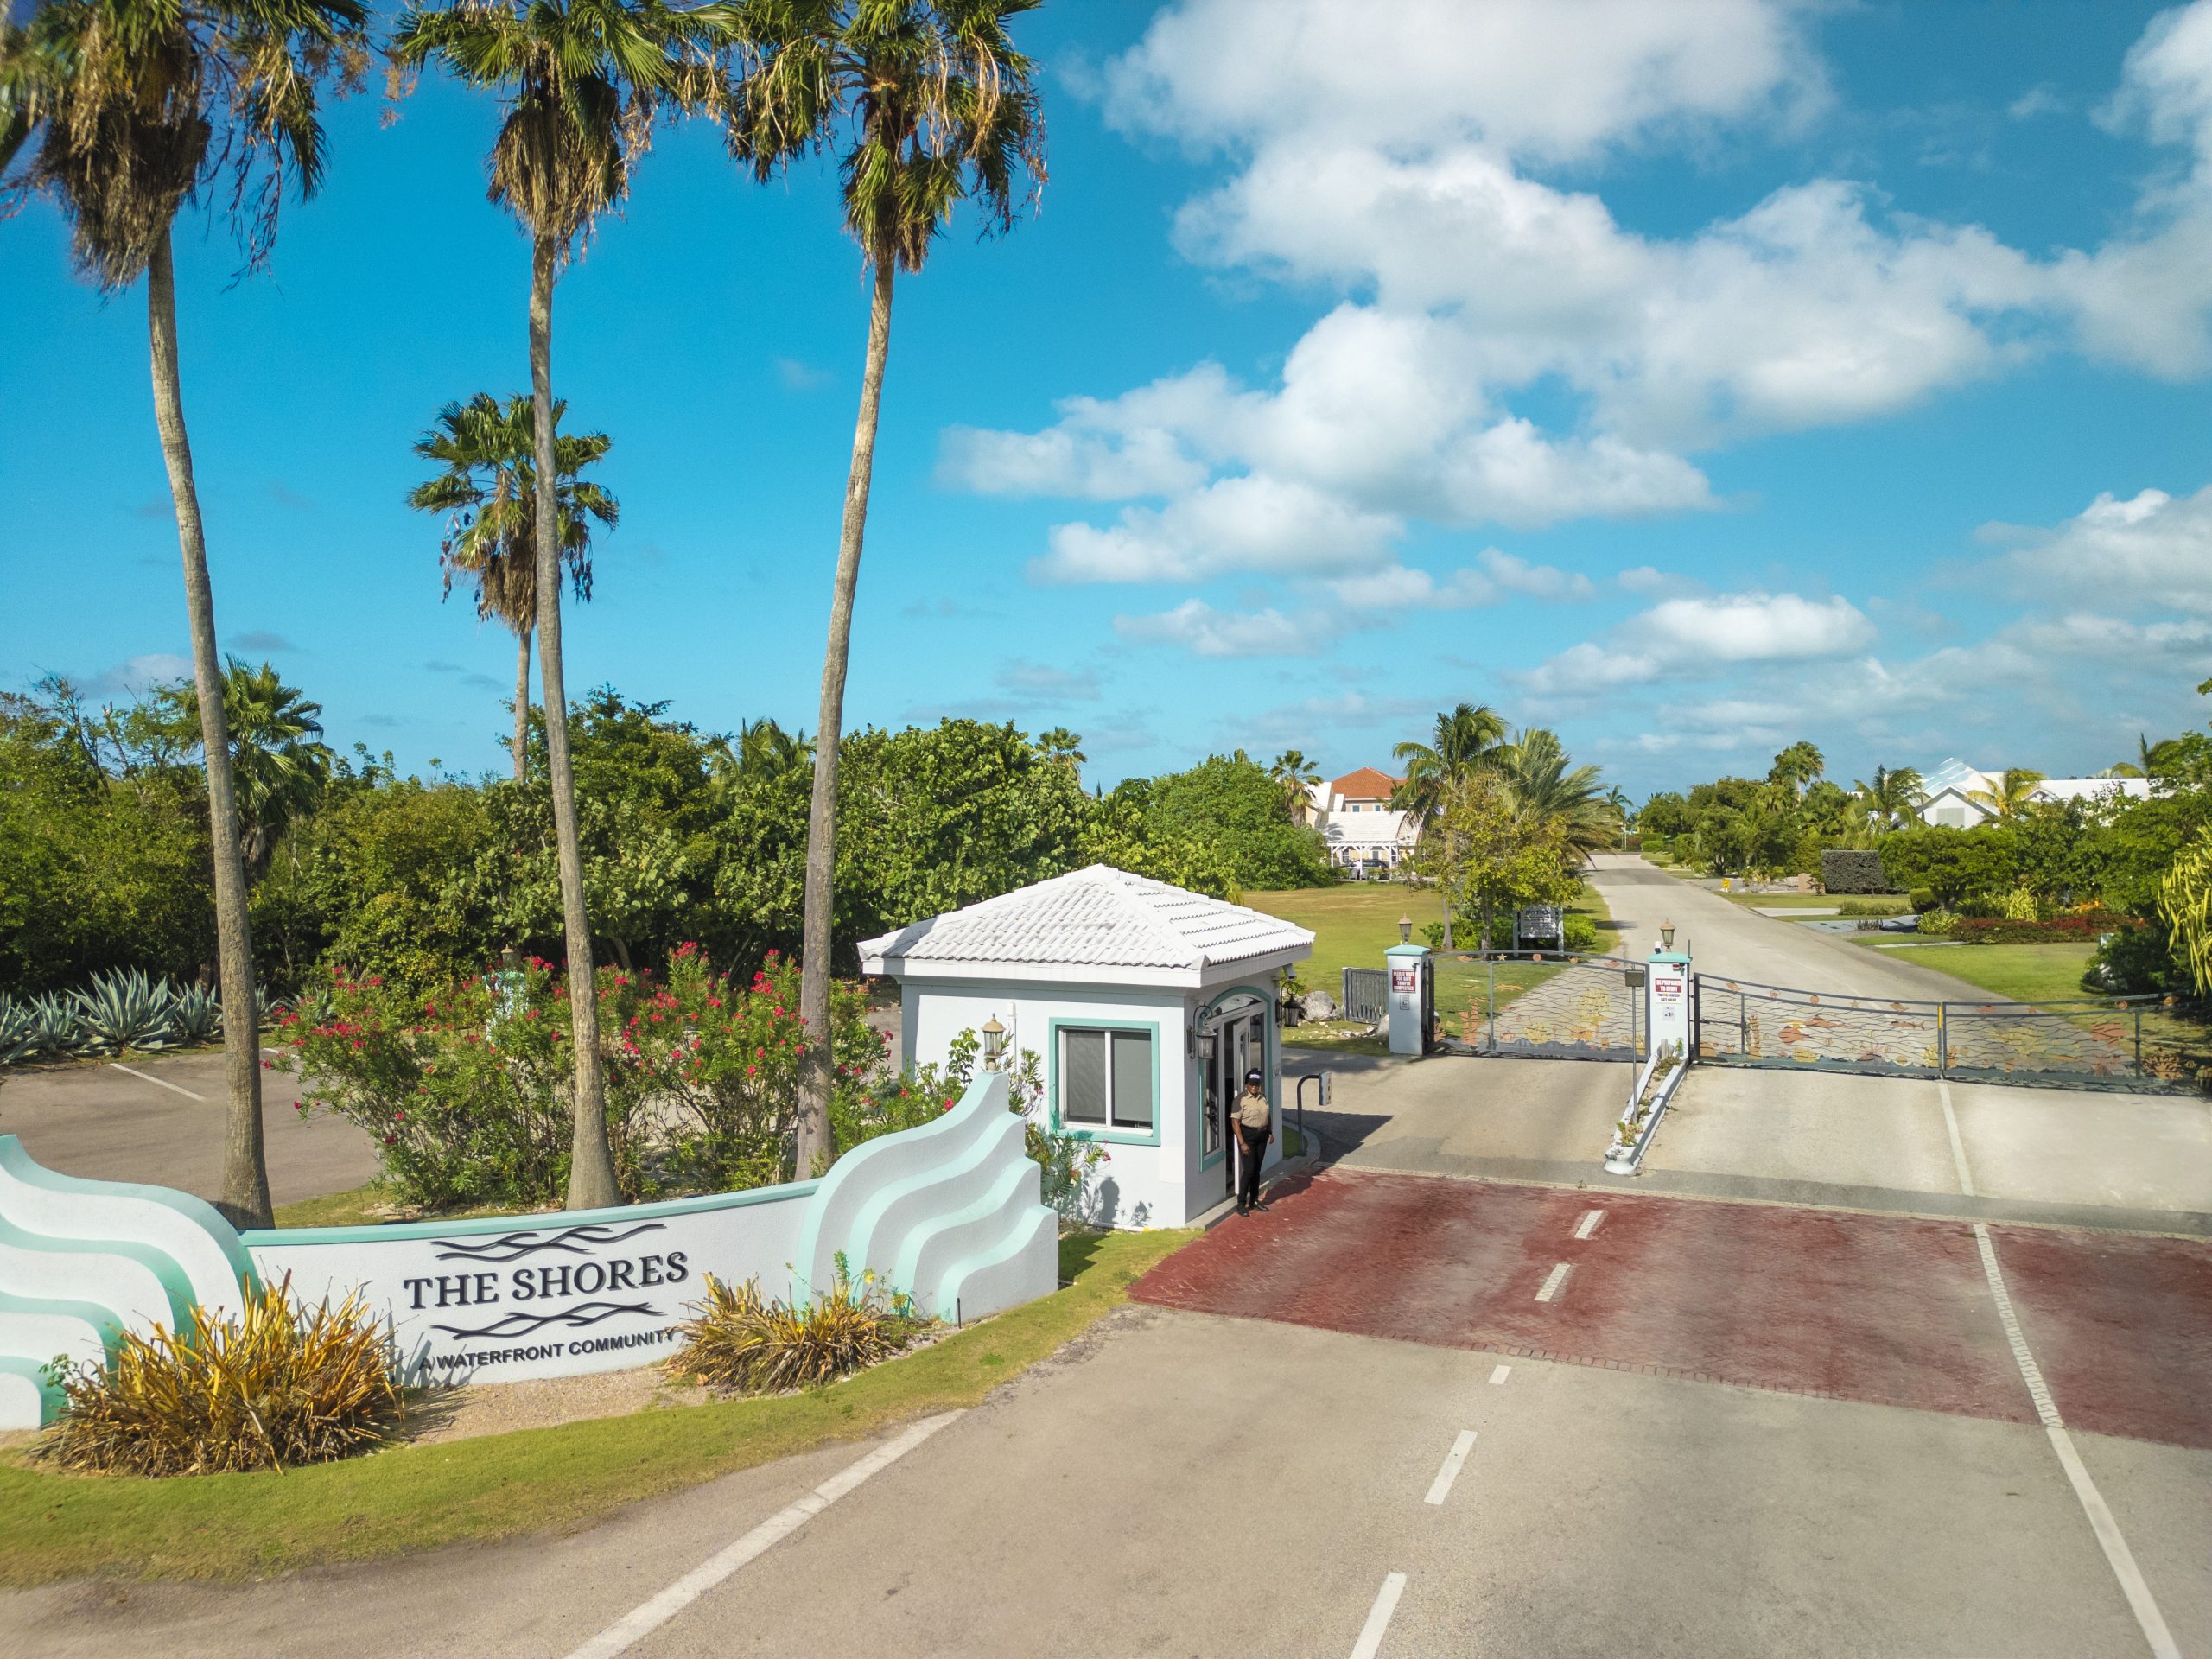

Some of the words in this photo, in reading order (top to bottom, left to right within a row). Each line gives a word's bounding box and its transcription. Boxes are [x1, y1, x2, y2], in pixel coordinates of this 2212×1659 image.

[404, 1273, 499, 1309] THE
[512, 1252, 688, 1301] SHORES
[419, 1357, 431, 1370] A
[437, 1343, 564, 1369] WATERFRONT
